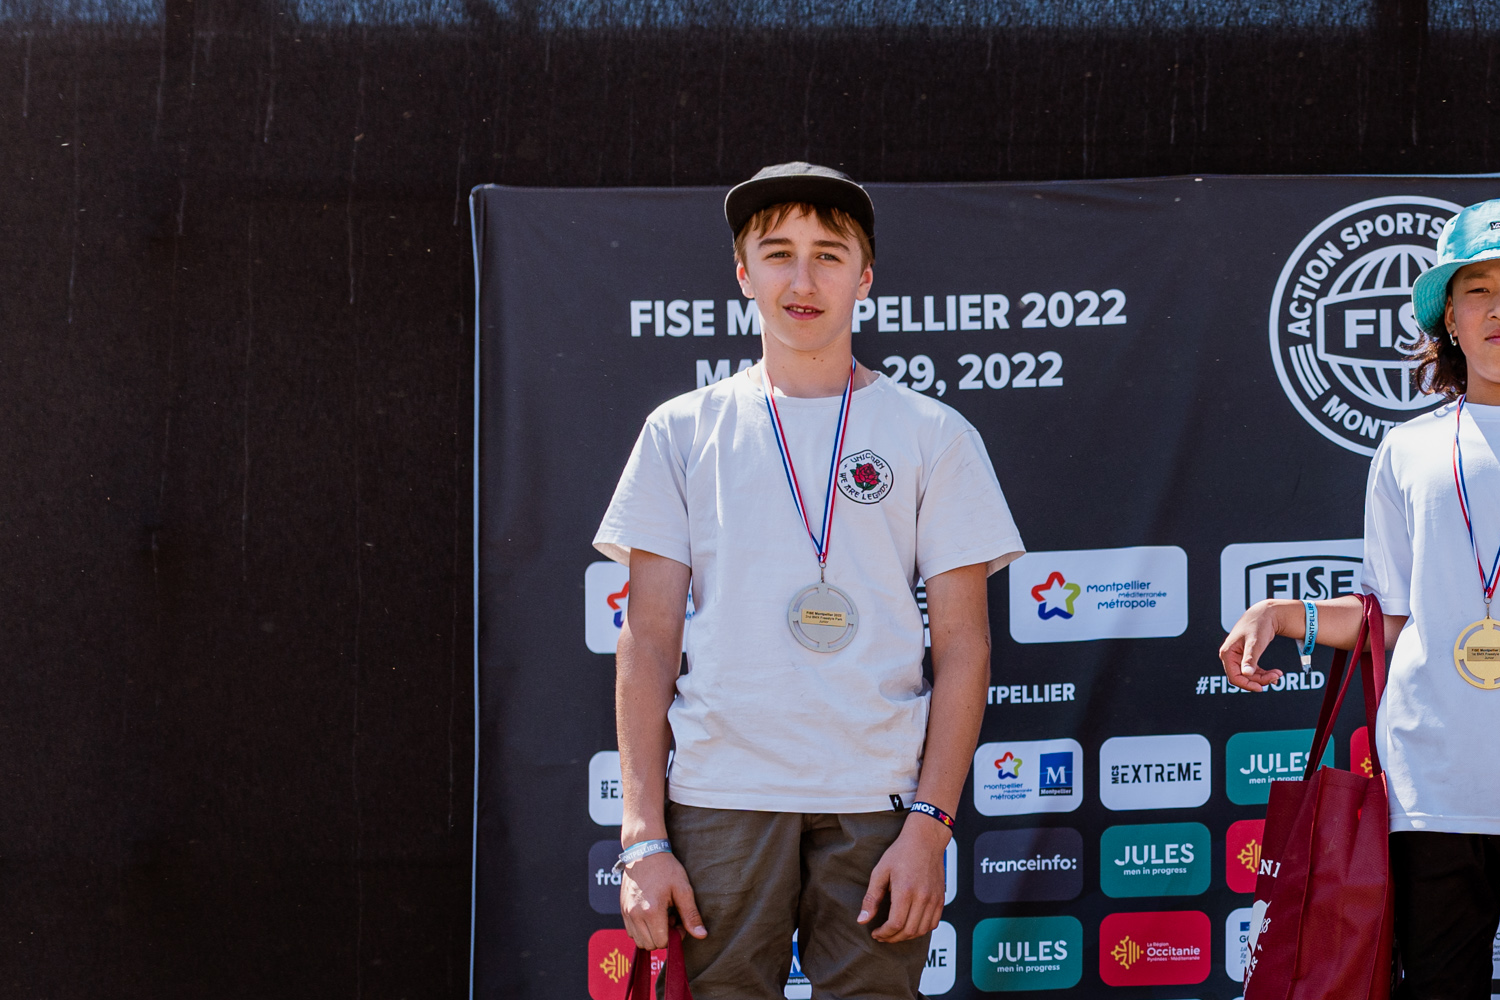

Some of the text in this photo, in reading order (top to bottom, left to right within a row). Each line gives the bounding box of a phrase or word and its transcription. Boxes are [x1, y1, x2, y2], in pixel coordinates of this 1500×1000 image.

[1288, 241, 1344, 337] ACTION
[631, 300, 715, 337] FISE
[1022, 289, 1127, 328] 2022
[957, 351, 1063, 389] 2022
[1266, 567, 1354, 599] FISE
[1121, 762, 1202, 783] EXTREME
[980, 854, 1077, 873] franceinfo:
[1114, 843, 1194, 866] JULES
[1152, 867, 1187, 875] progress
[988, 940, 1068, 962] JULES
[1147, 946, 1200, 956] Occitanie
[1016, 964, 1024, 972] in
[1026, 964, 1060, 974] progress
